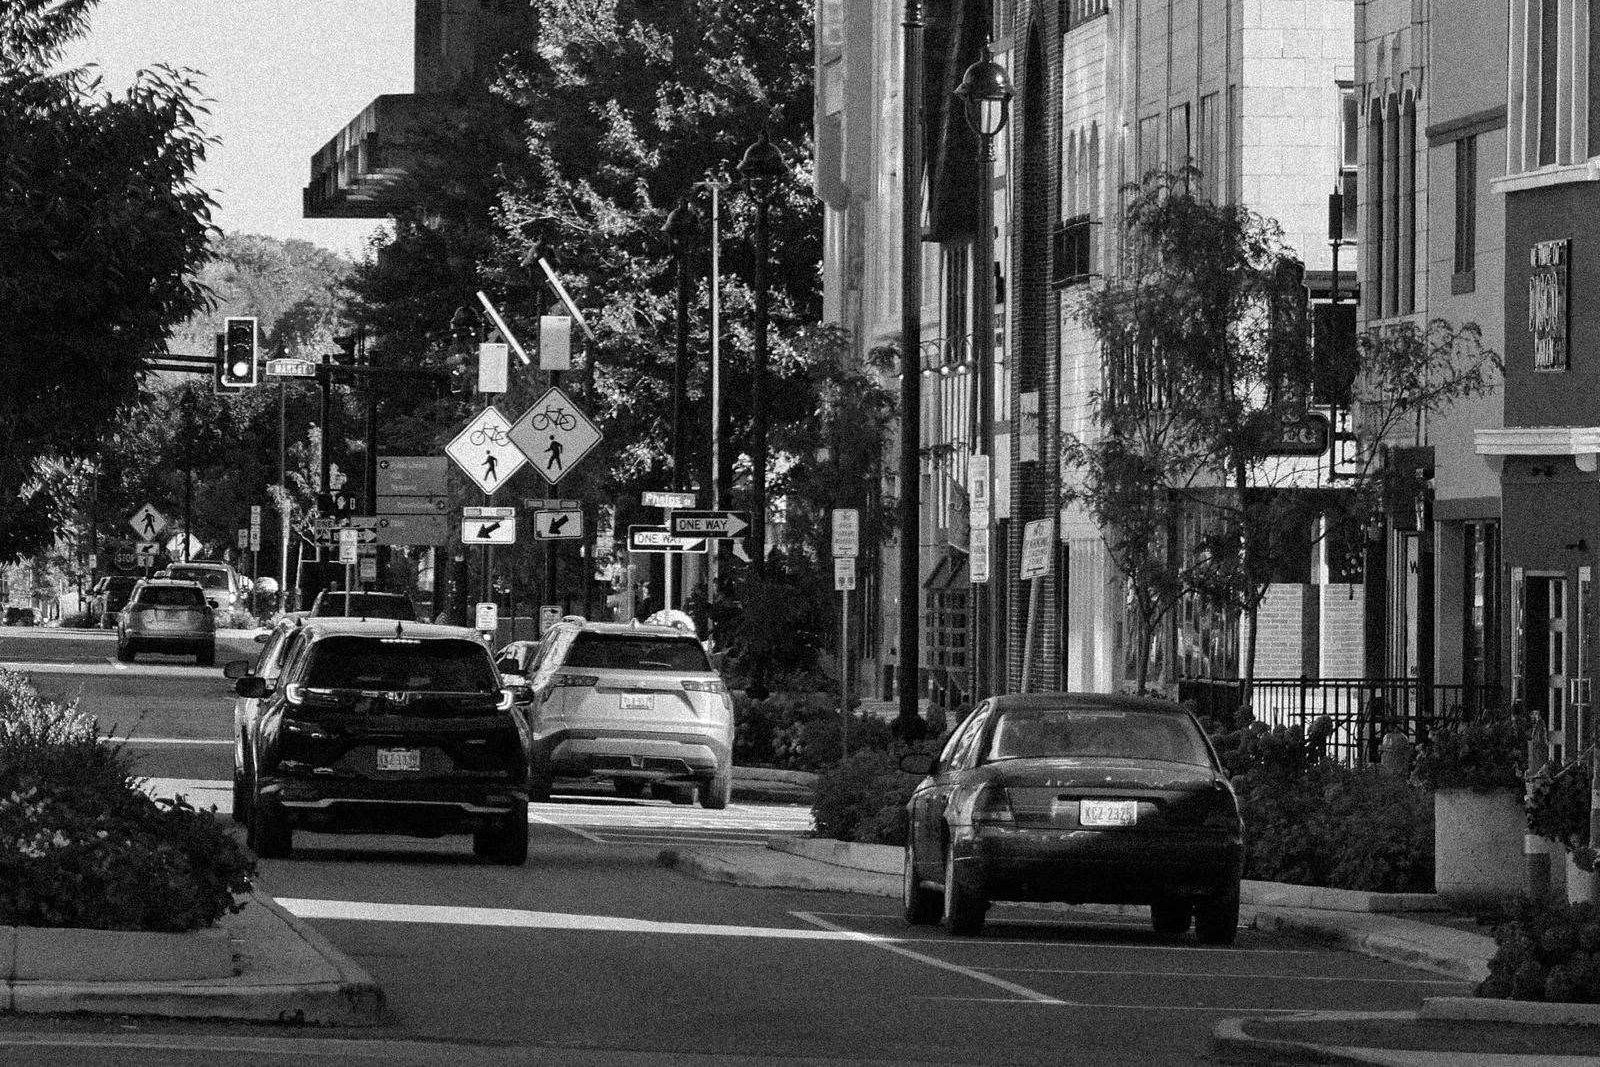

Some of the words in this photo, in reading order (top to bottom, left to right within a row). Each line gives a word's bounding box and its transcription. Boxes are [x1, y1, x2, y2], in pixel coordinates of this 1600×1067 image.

[275, 364, 307, 374] MARKET
[645, 493, 681, 506] Phelps
[679, 519, 701, 530] ONE
[705, 519, 728, 530] WAY
[637, 534, 659, 543] ONE
[116, 553, 136, 563] STOP
